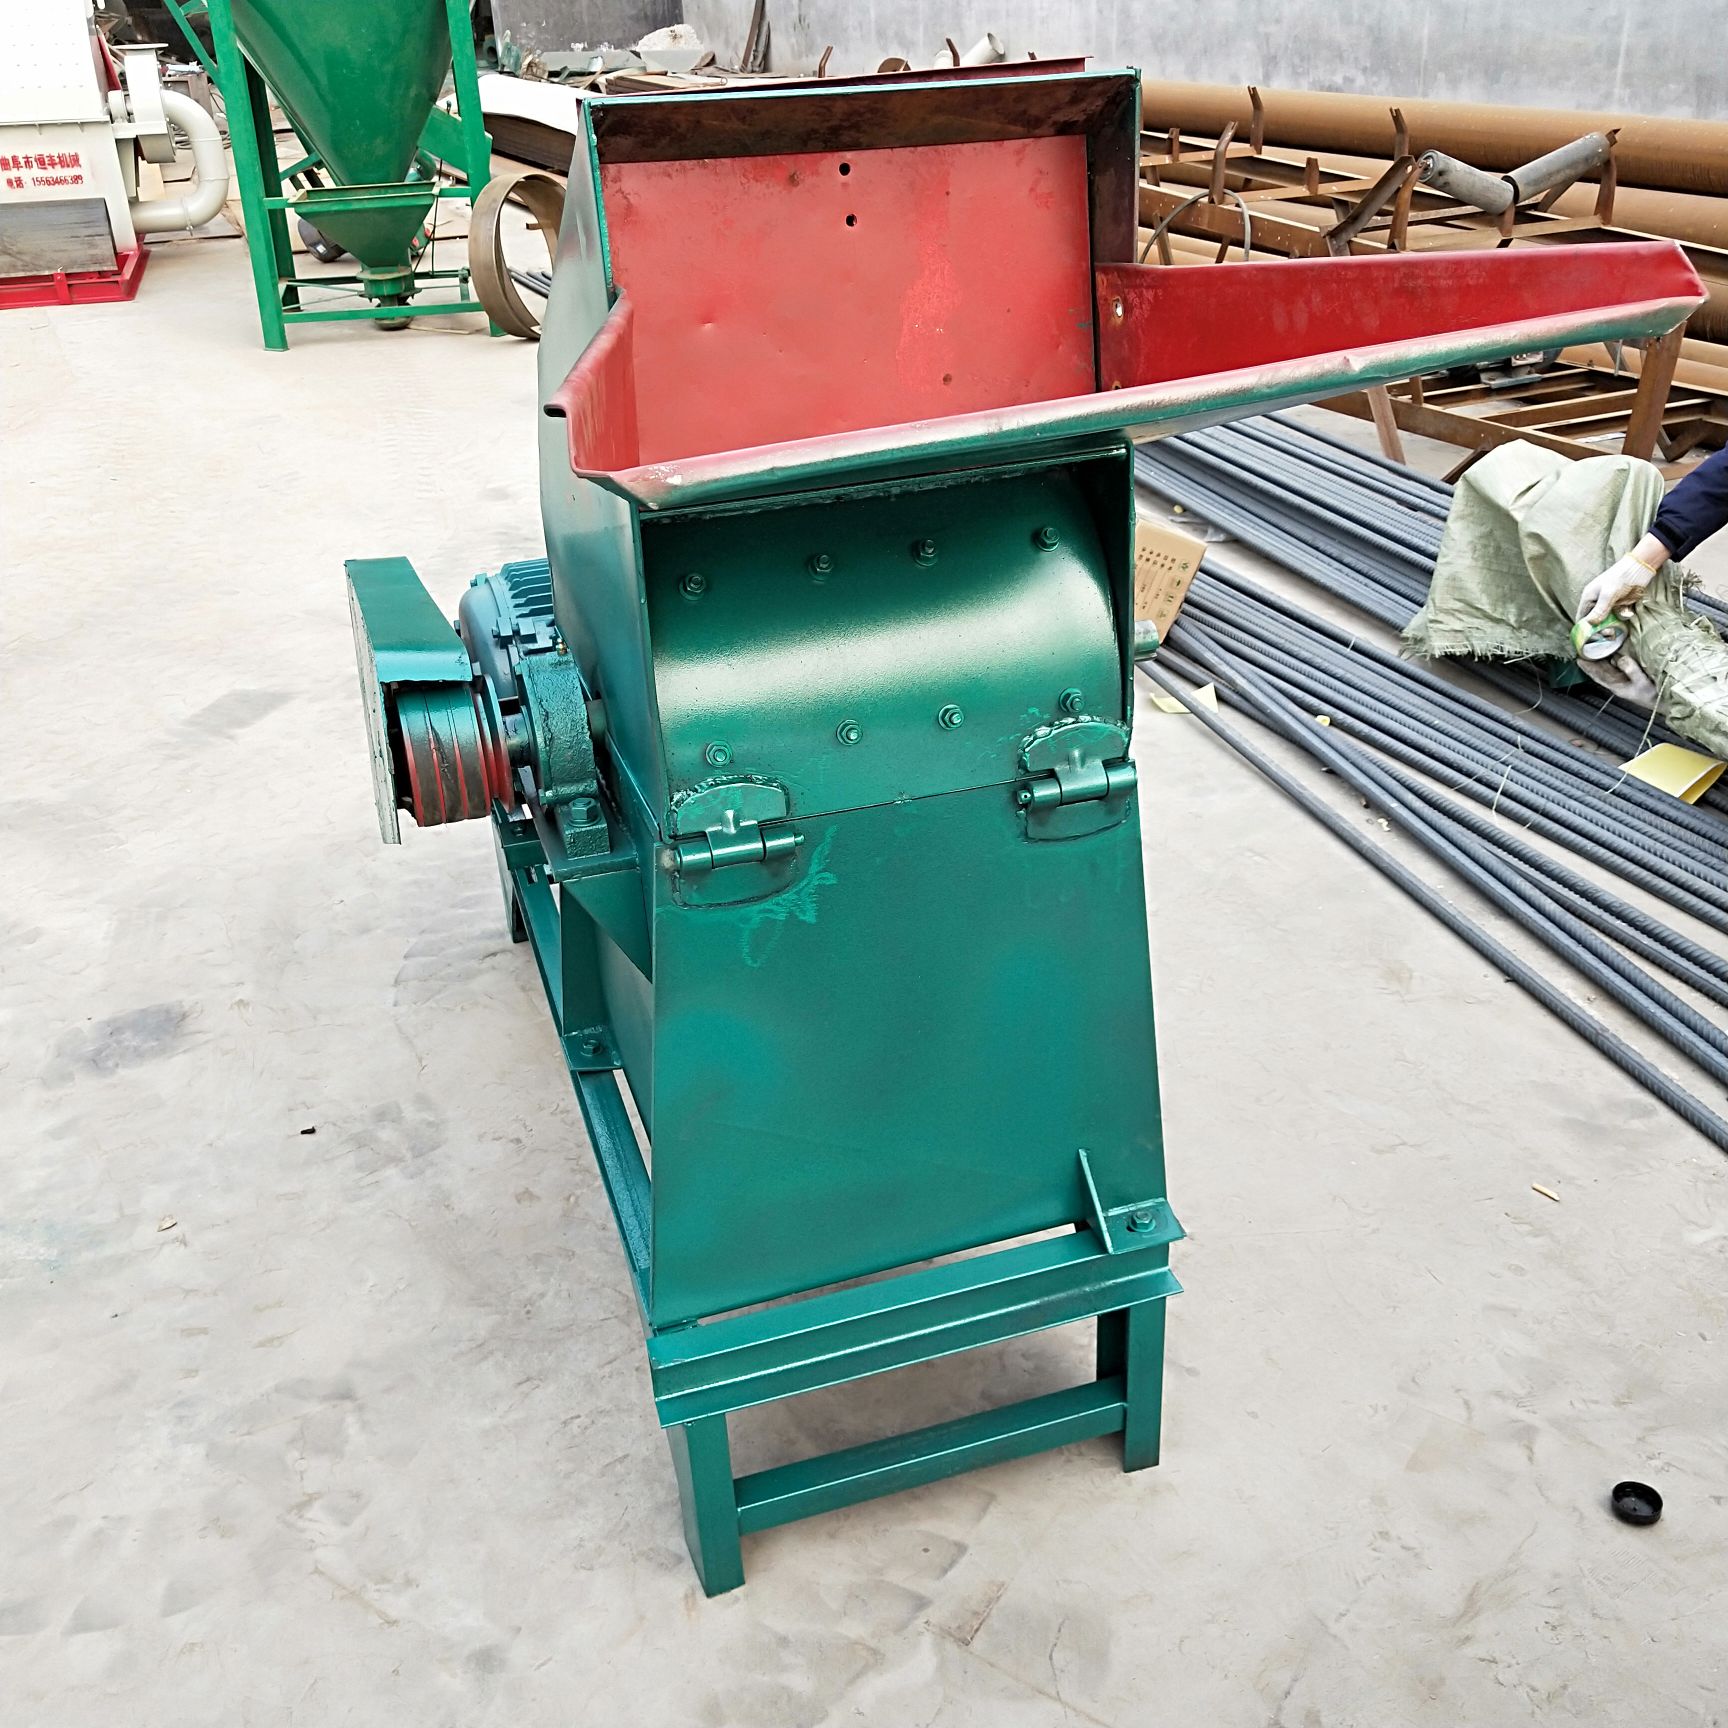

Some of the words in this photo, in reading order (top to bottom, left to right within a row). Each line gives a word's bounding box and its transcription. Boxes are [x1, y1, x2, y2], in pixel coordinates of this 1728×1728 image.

[0, 152, 82, 171] 曲阜市恒丰机械
[32, 174, 84, 187] 15563466389
